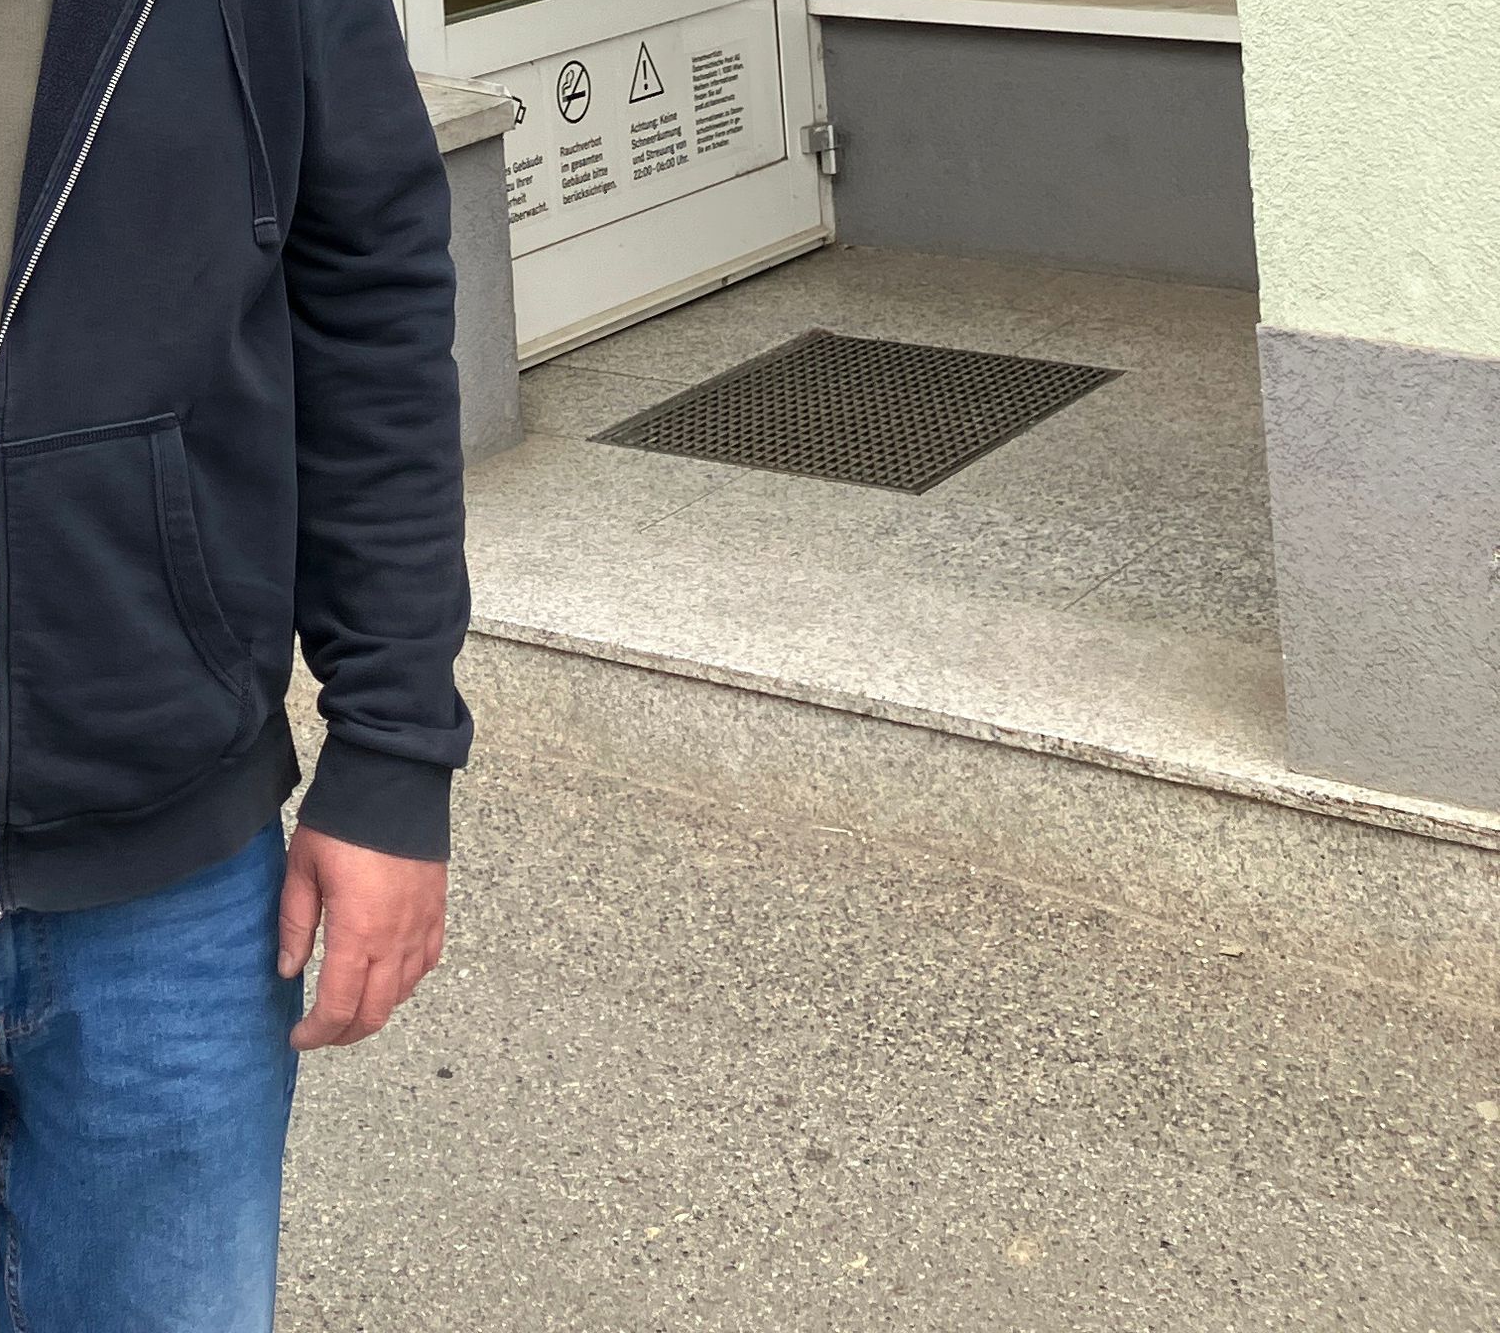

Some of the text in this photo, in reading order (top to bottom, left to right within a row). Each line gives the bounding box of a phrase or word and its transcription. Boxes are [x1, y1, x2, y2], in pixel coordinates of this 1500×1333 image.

[660, 112, 677, 124] Keine
[560, 136, 602, 157] Rauchverbot
[631, 125, 681, 150] Schneeräumung
[561, 153, 603, 173] im gesamten
[632, 140, 687, 165] und Streuung von
[513, 155, 543, 173] Gebäude
[516, 175, 533, 188] Ihrer
[562, 167, 608, 189] Gebäude bitte
[563, 181, 617, 204] berücksichtigen.
